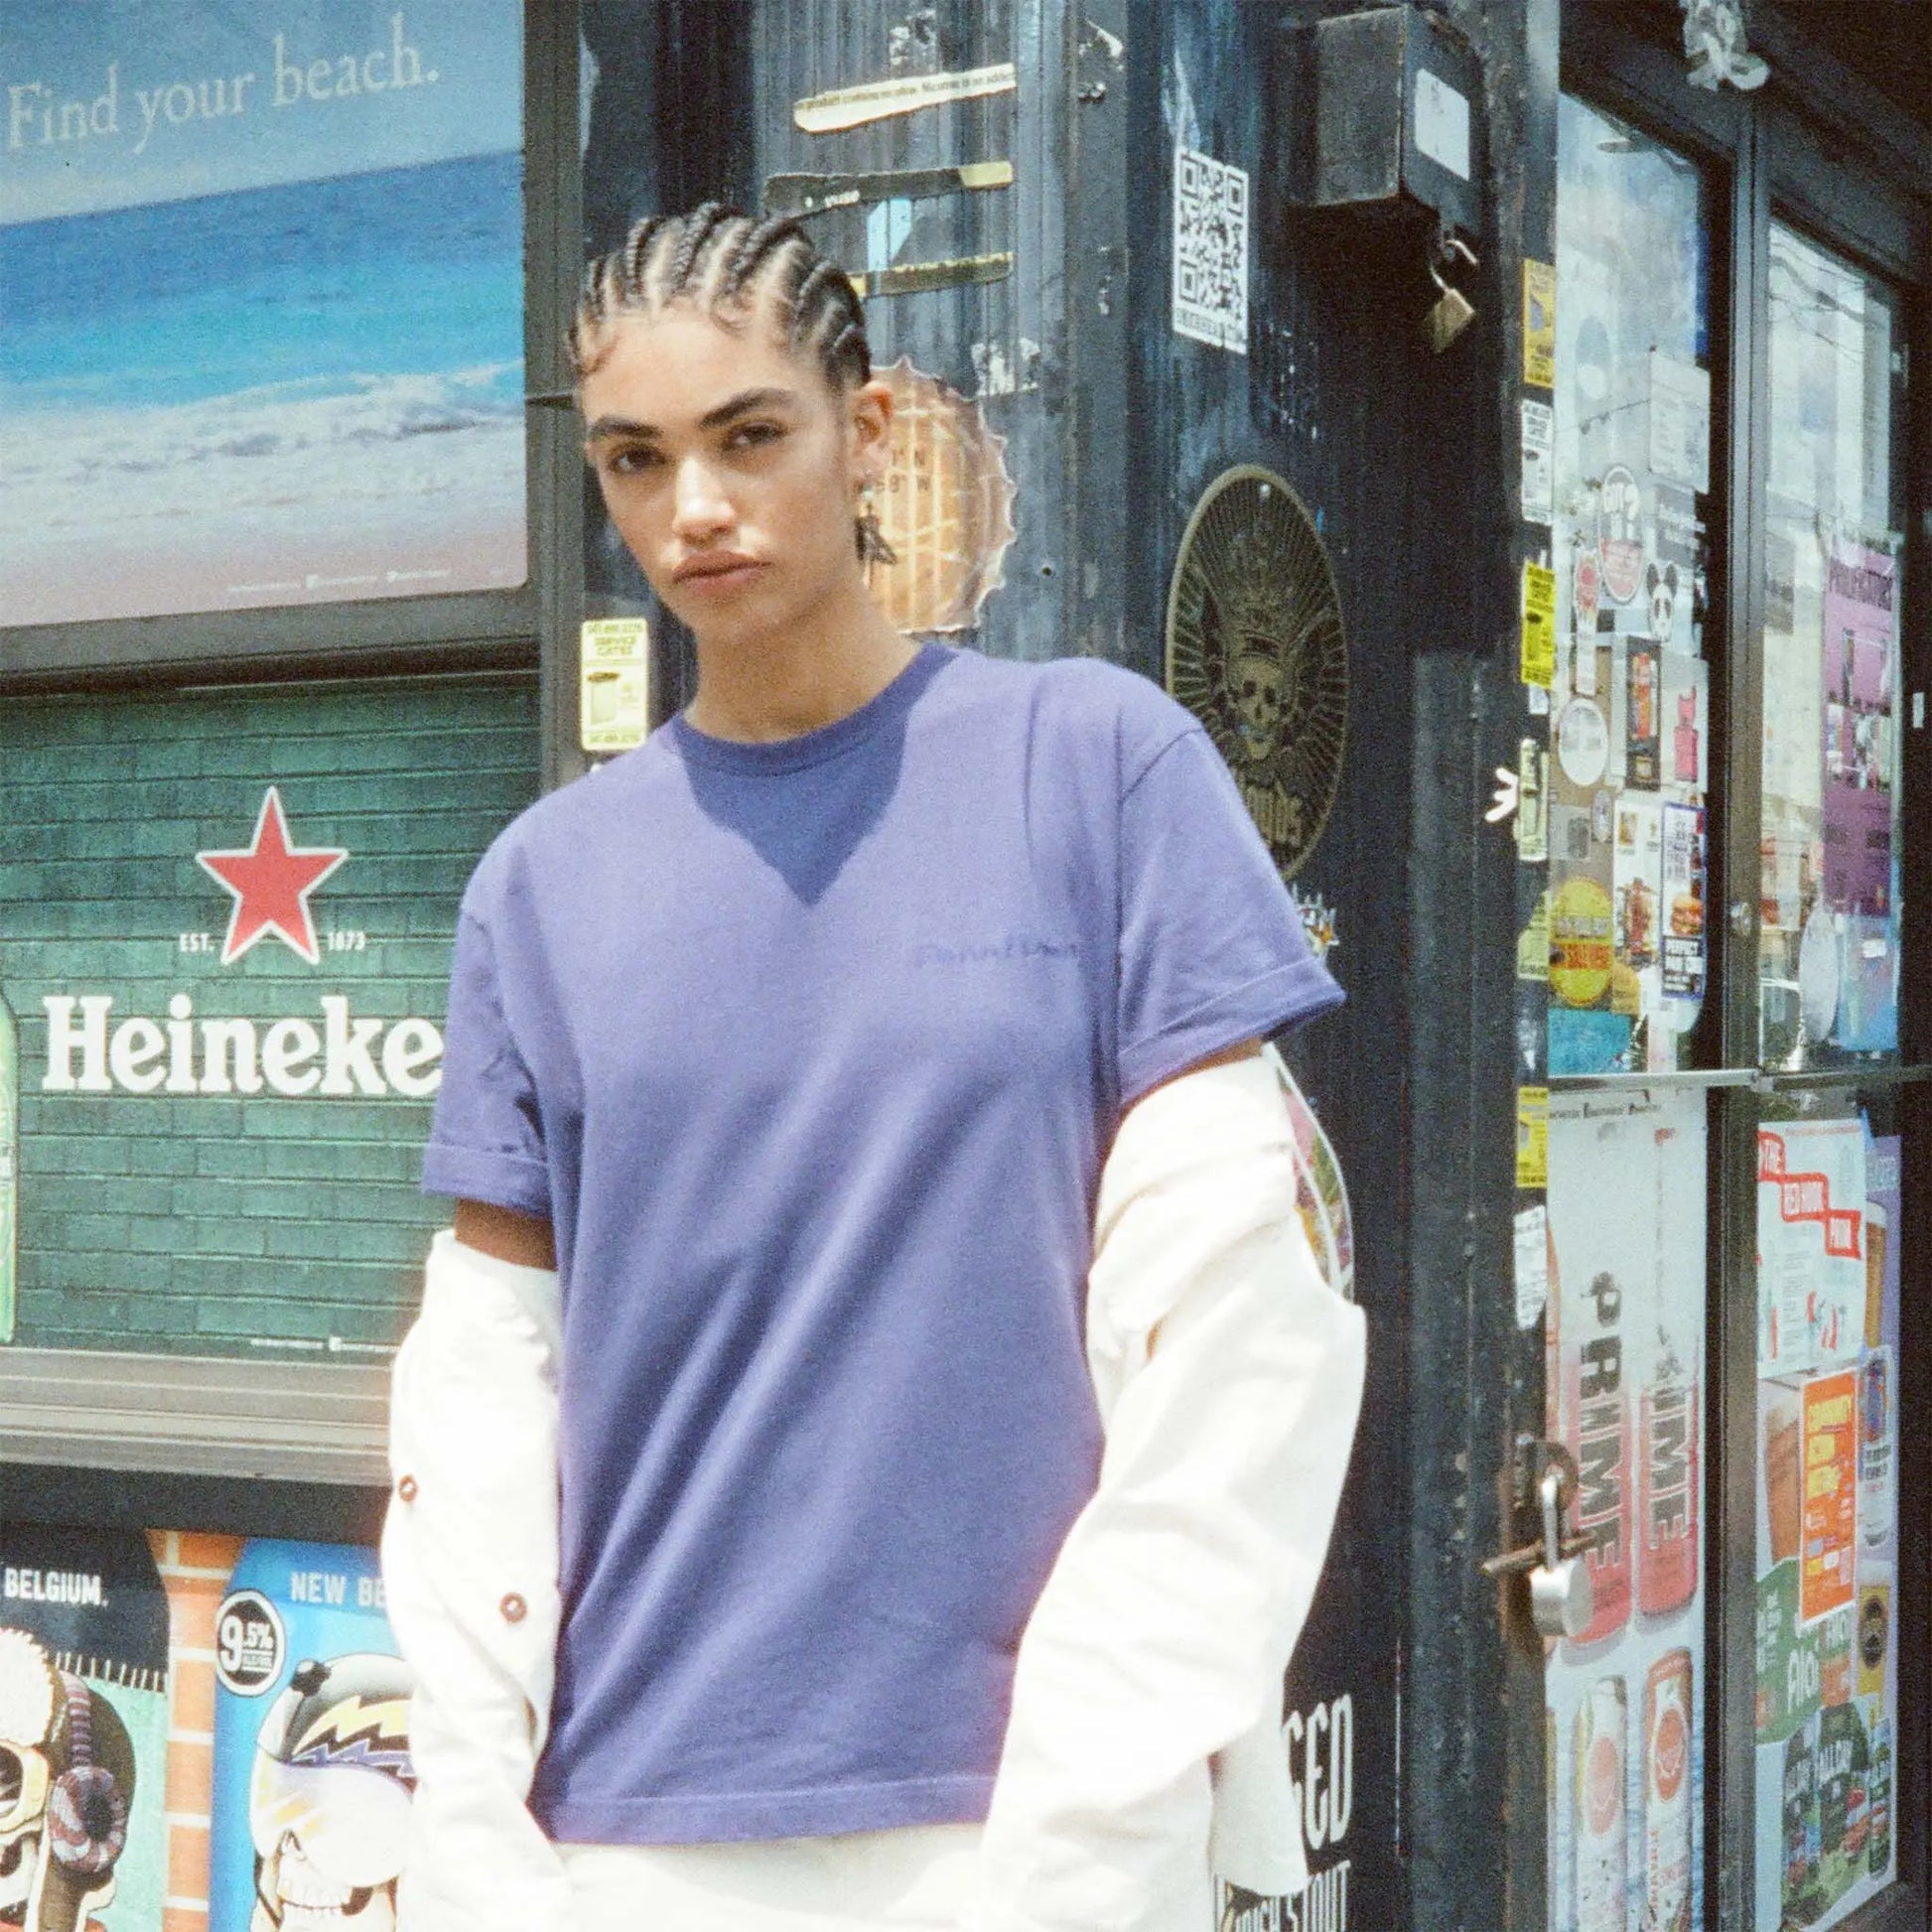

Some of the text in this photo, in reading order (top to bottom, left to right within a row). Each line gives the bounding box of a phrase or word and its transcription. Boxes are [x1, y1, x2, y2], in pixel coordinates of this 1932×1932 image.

[8, 11, 440, 156] Find your beach.
[180, 930, 366, 953] EST. 1873
[290, 1571, 347, 1605] NEW
